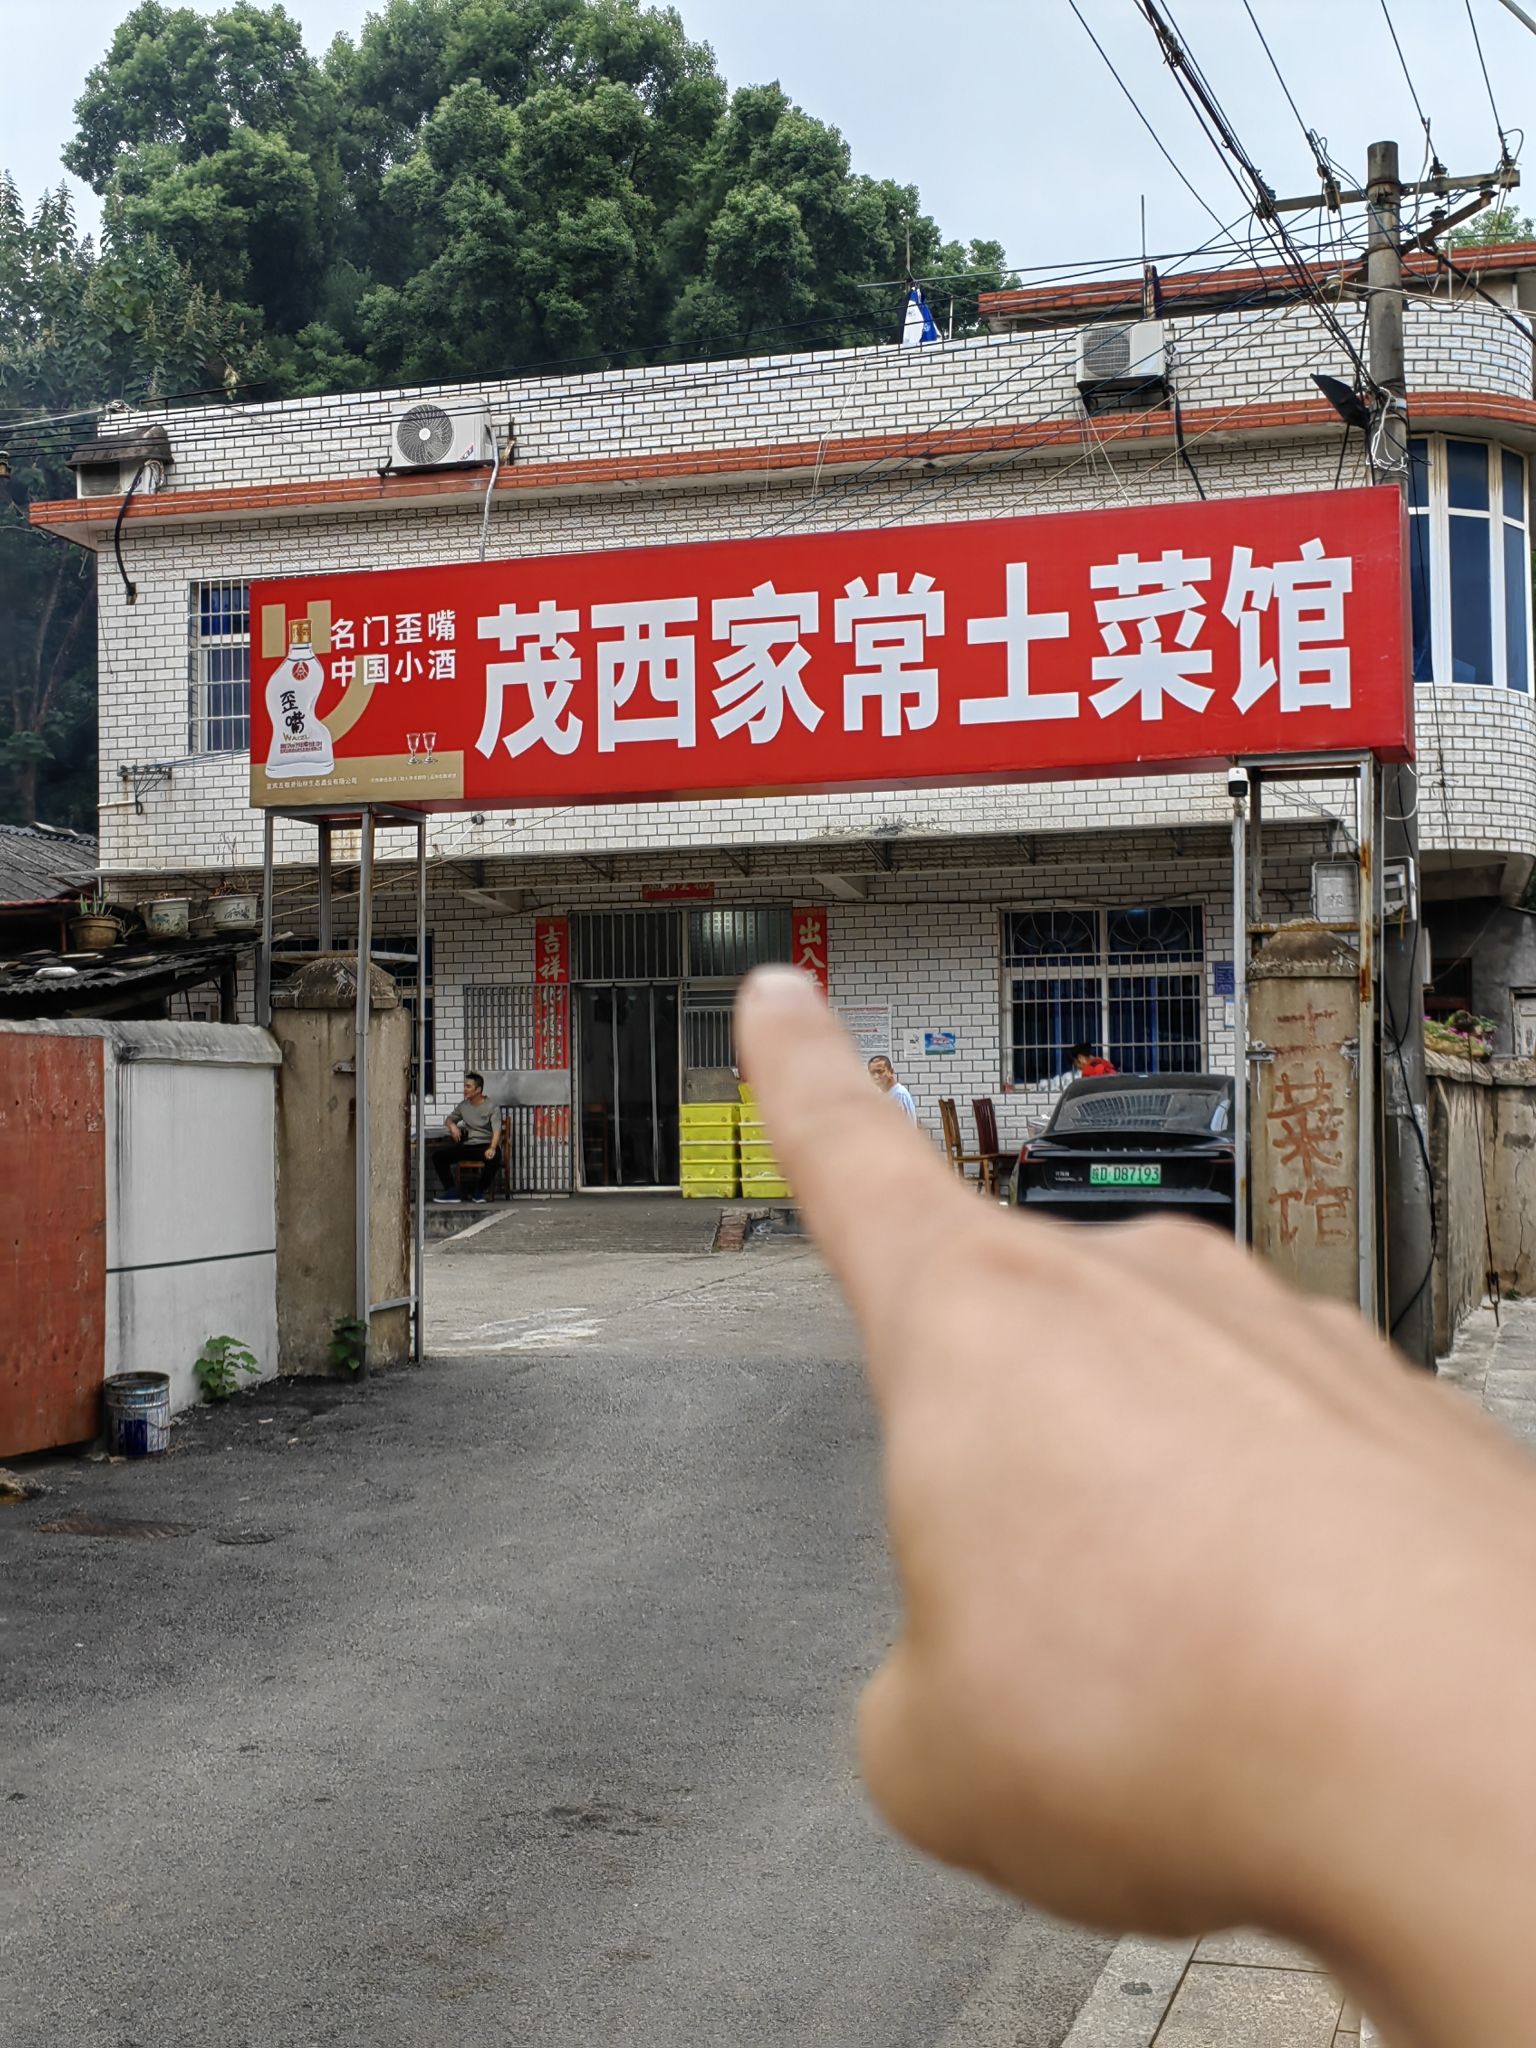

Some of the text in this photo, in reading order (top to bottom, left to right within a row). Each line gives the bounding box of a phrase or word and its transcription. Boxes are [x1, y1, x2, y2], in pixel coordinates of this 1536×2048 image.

[330, 609, 456, 650] 名门歪嘴
[475, 537, 1353, 759] 茂西家常土菜馆
[330, 649, 456, 688] 中国小酒
[280, 690, 306, 734] 歪嘴
